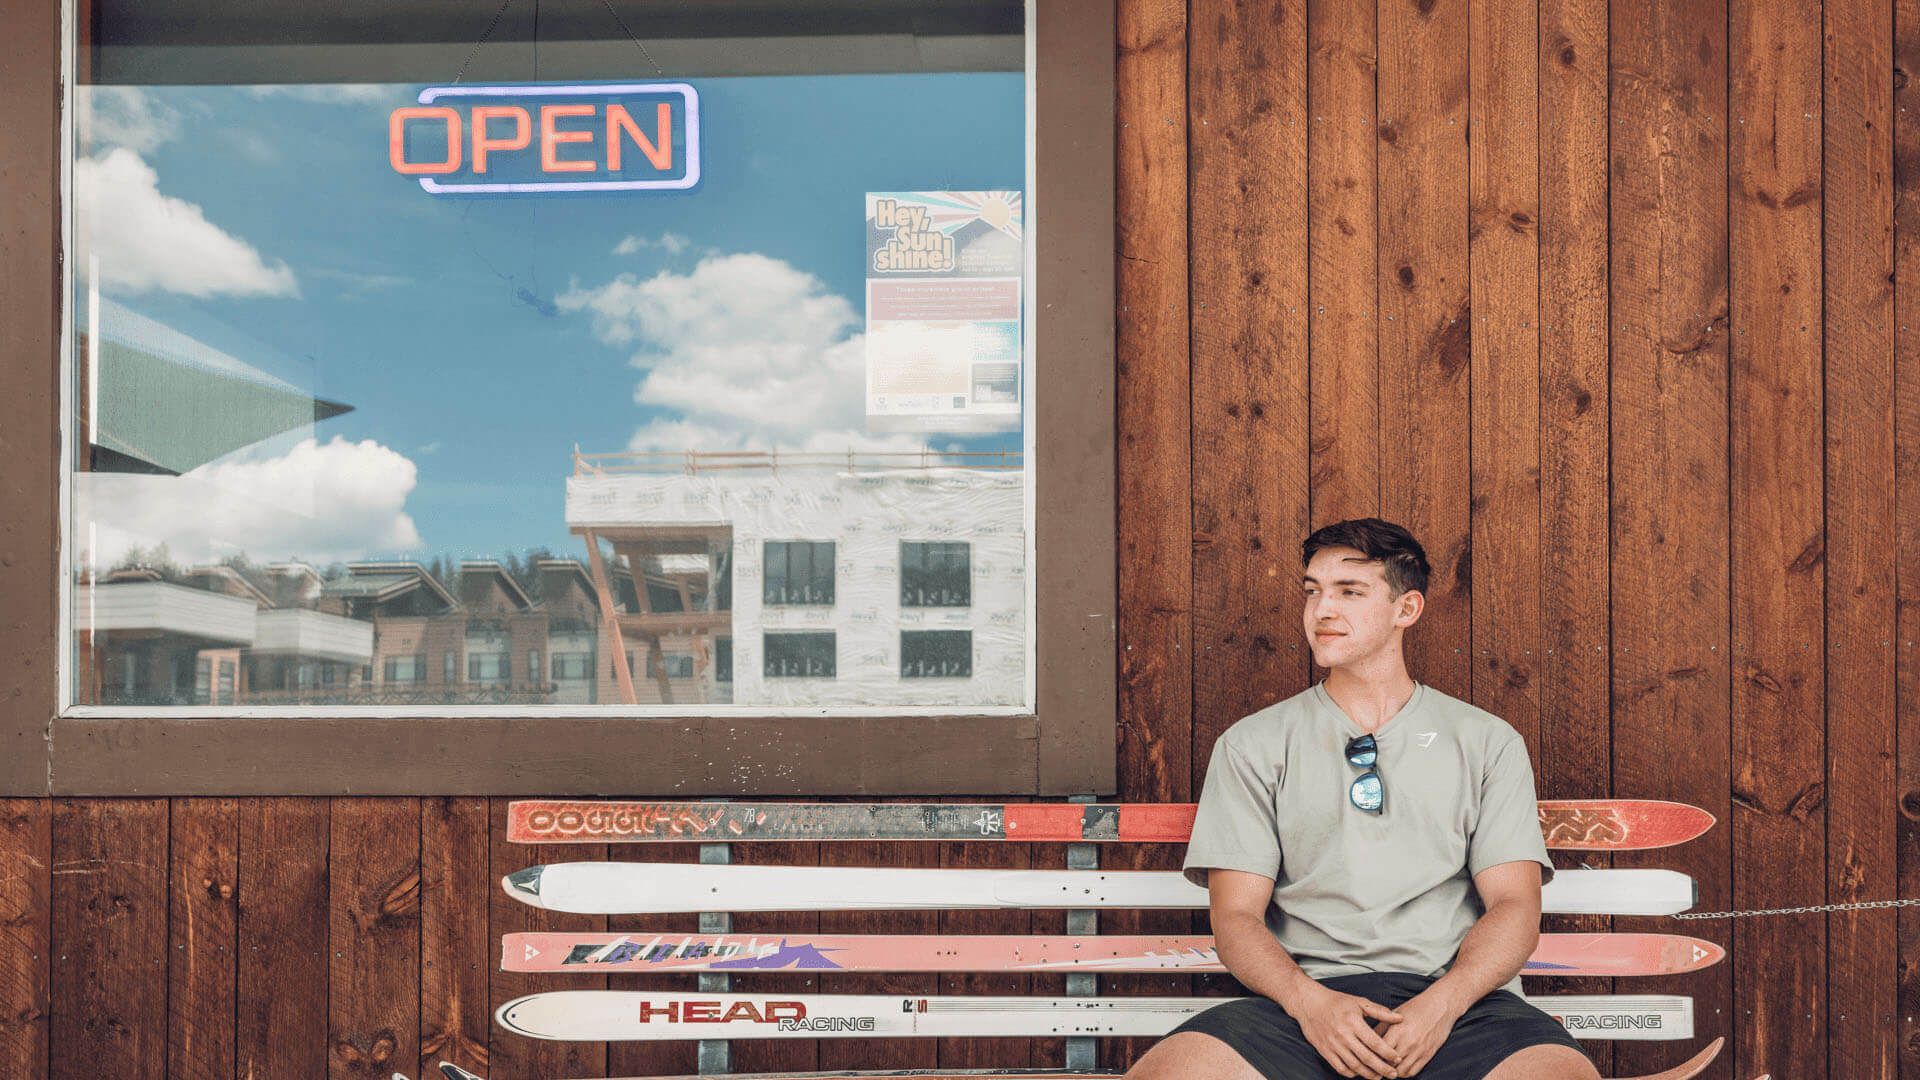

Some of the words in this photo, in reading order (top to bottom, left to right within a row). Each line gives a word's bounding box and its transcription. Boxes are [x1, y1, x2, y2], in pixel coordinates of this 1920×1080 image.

[389, 103, 672, 174] OPEN
[876, 199, 931, 232] Hey,
[897, 226, 943, 250] Sun
[876, 237, 952, 269] shine!
[640, 1001, 807, 1023] HEAD
[778, 1016, 875, 1031] RACING
[1565, 1015, 1662, 1029] RACING
